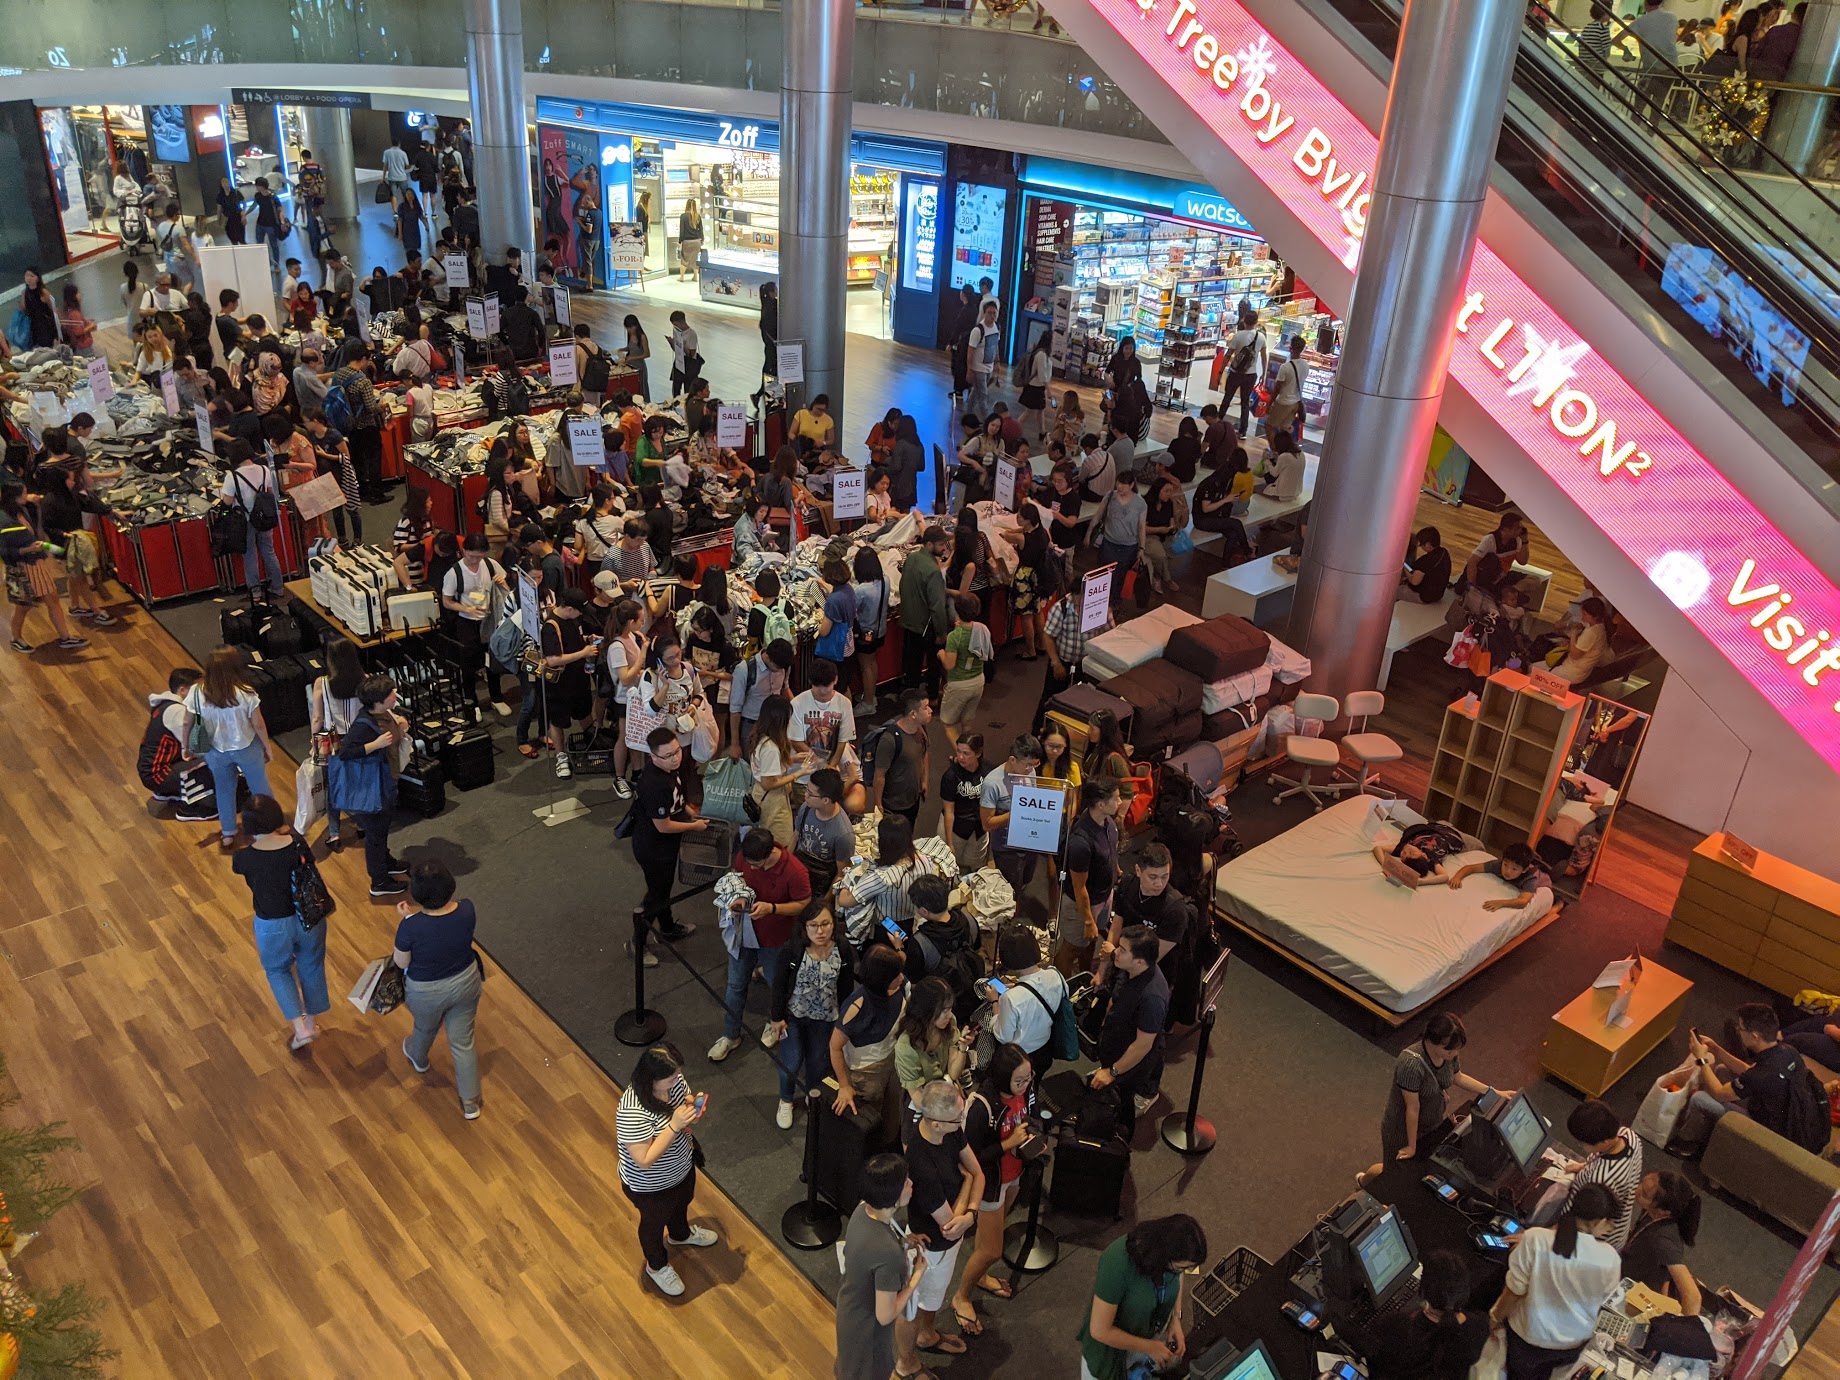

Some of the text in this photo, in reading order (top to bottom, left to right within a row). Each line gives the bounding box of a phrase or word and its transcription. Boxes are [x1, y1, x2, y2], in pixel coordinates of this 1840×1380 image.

[1166, 0, 1238, 90] Tree
[1239, 74, 1294, 143] by
[717, 122, 759, 148] Zoff
[543, 138, 593, 157] Zoff SMART
[1037, 228, 1061, 236] SUPPLEMENTS
[613, 255, 643, 263] 1-FOR-1
[555, 294, 566, 303] SALE
[469, 308, 482, 316] SALE
[486, 303, 497, 313] SALE
[552, 352, 572, 361] SALE
[91, 363, 107, 376] SALE
[196, 411, 208, 423] SALE
[721, 412, 743, 420] SALE
[573, 429, 598, 437] SALE
[999, 467, 1013, 481] SALE
[838, 479, 861, 489] SALE
[1088, 583, 1108, 597] SALE
[521, 587, 534, 606] SALE
[1727, 558, 1840, 686] Visit
[1550, 681, 1565, 690] OFF
[1018, 796, 1057, 811] SALE
